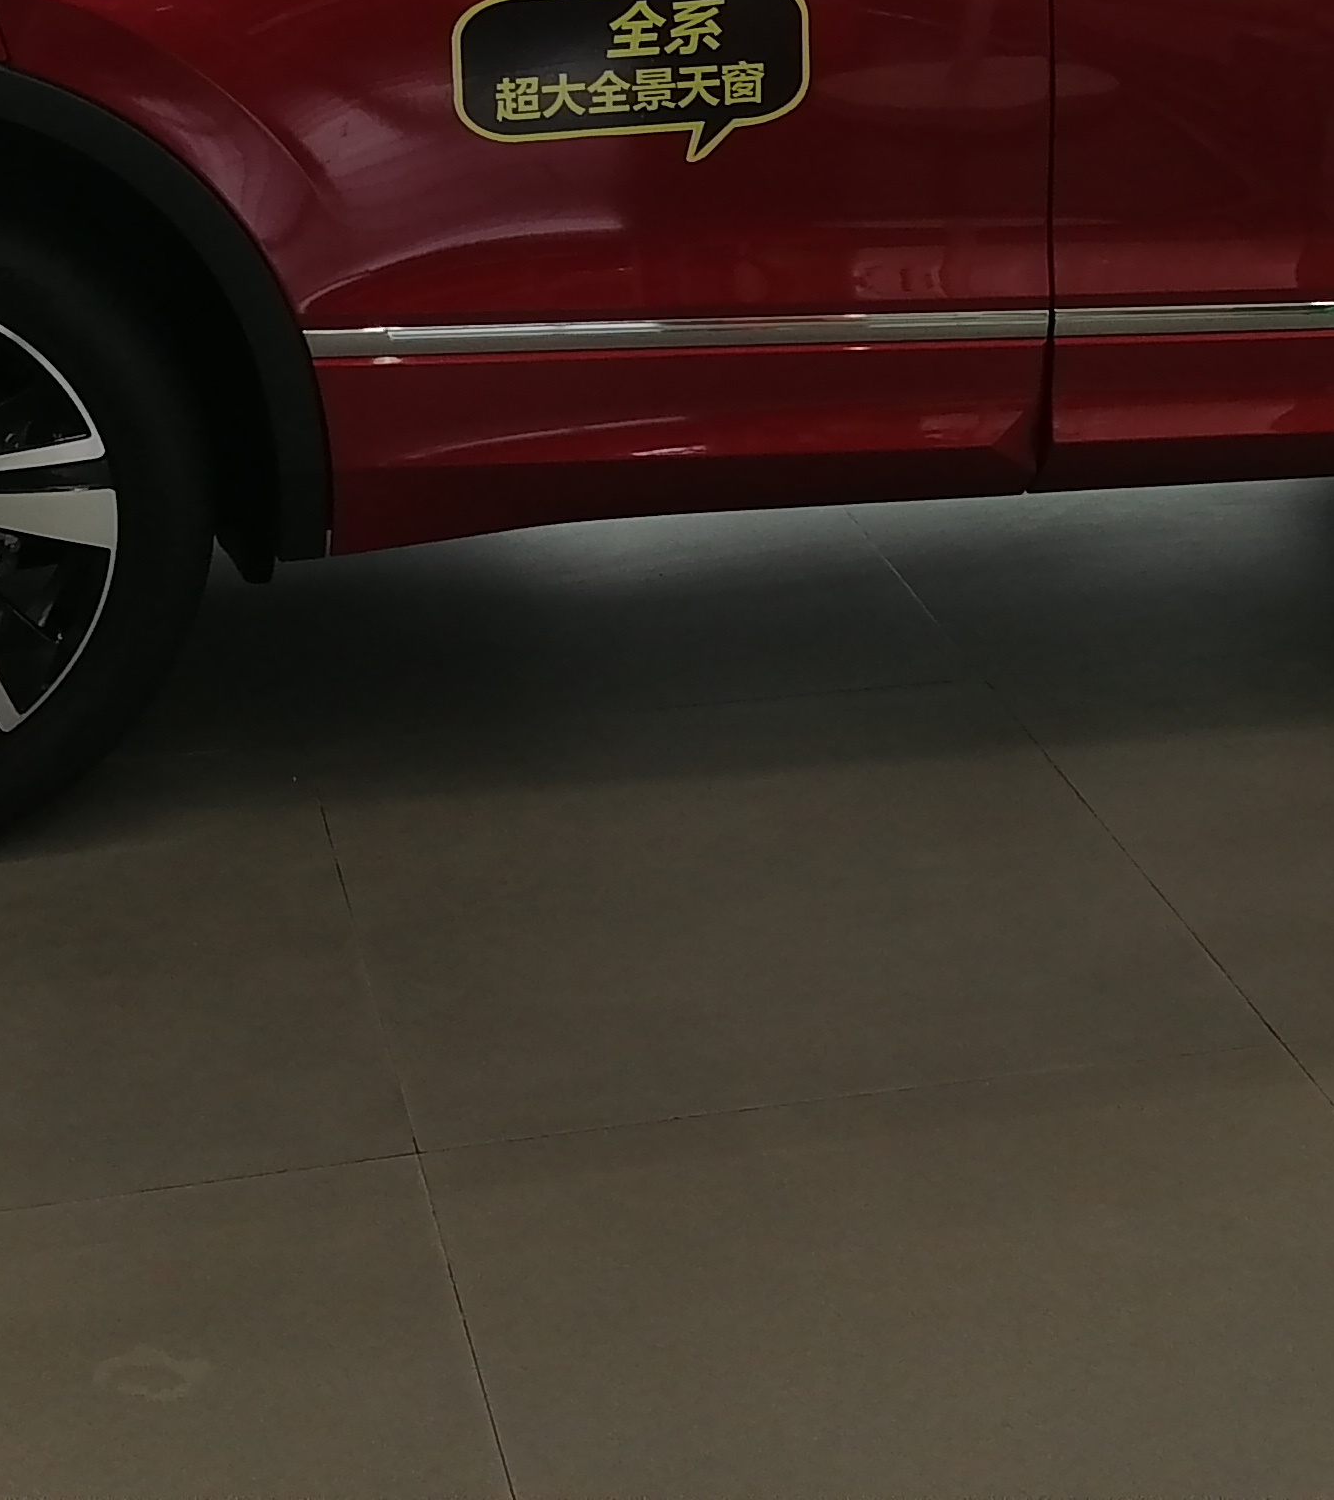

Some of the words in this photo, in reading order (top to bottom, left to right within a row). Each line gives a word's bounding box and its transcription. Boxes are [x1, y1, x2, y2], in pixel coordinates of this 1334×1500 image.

[495, 61, 766, 122] 超大全景天窗
